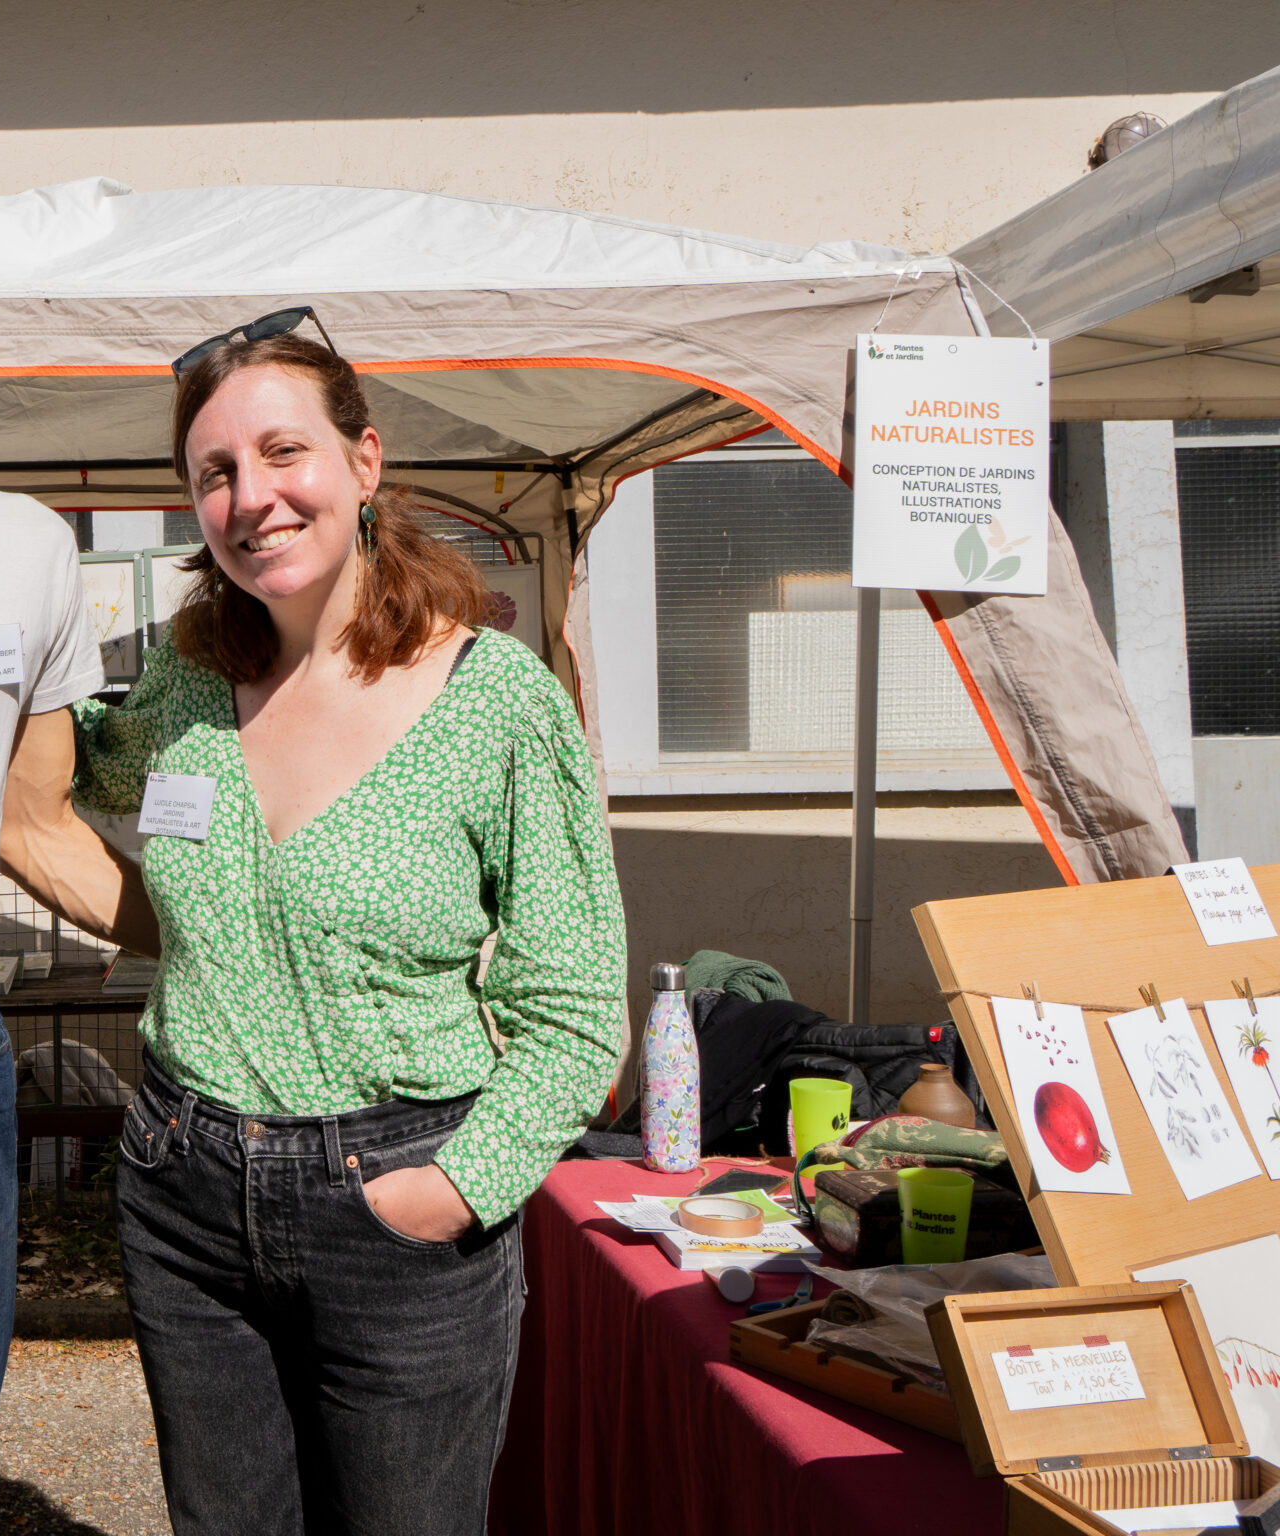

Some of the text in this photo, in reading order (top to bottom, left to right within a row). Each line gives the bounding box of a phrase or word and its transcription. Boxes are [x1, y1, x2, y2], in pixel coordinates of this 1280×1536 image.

[895, 353, 924, 361] Jardins
[905, 400, 1000, 419] JARDINS
[871, 424, 1035, 447] NATURALISTES
[872, 464, 1035, 480] CONCEPTION DE JARDINS
[902, 481, 1002, 495] NATURALISTES,
[901, 496, 1002, 510] ILLUSTRATIONS
[910, 511, 993, 525] BOTANIQUES
[3, 667, 15, 675] ART
[154, 799, 172, 807] LUCILE
[912, 1208, 957, 1222] Plantes
[915, 1222, 955, 1234] Jardins
[1048, 1351, 1060, 1371] À
[1062, 1350, 1126, 1368] MERVEILLES
